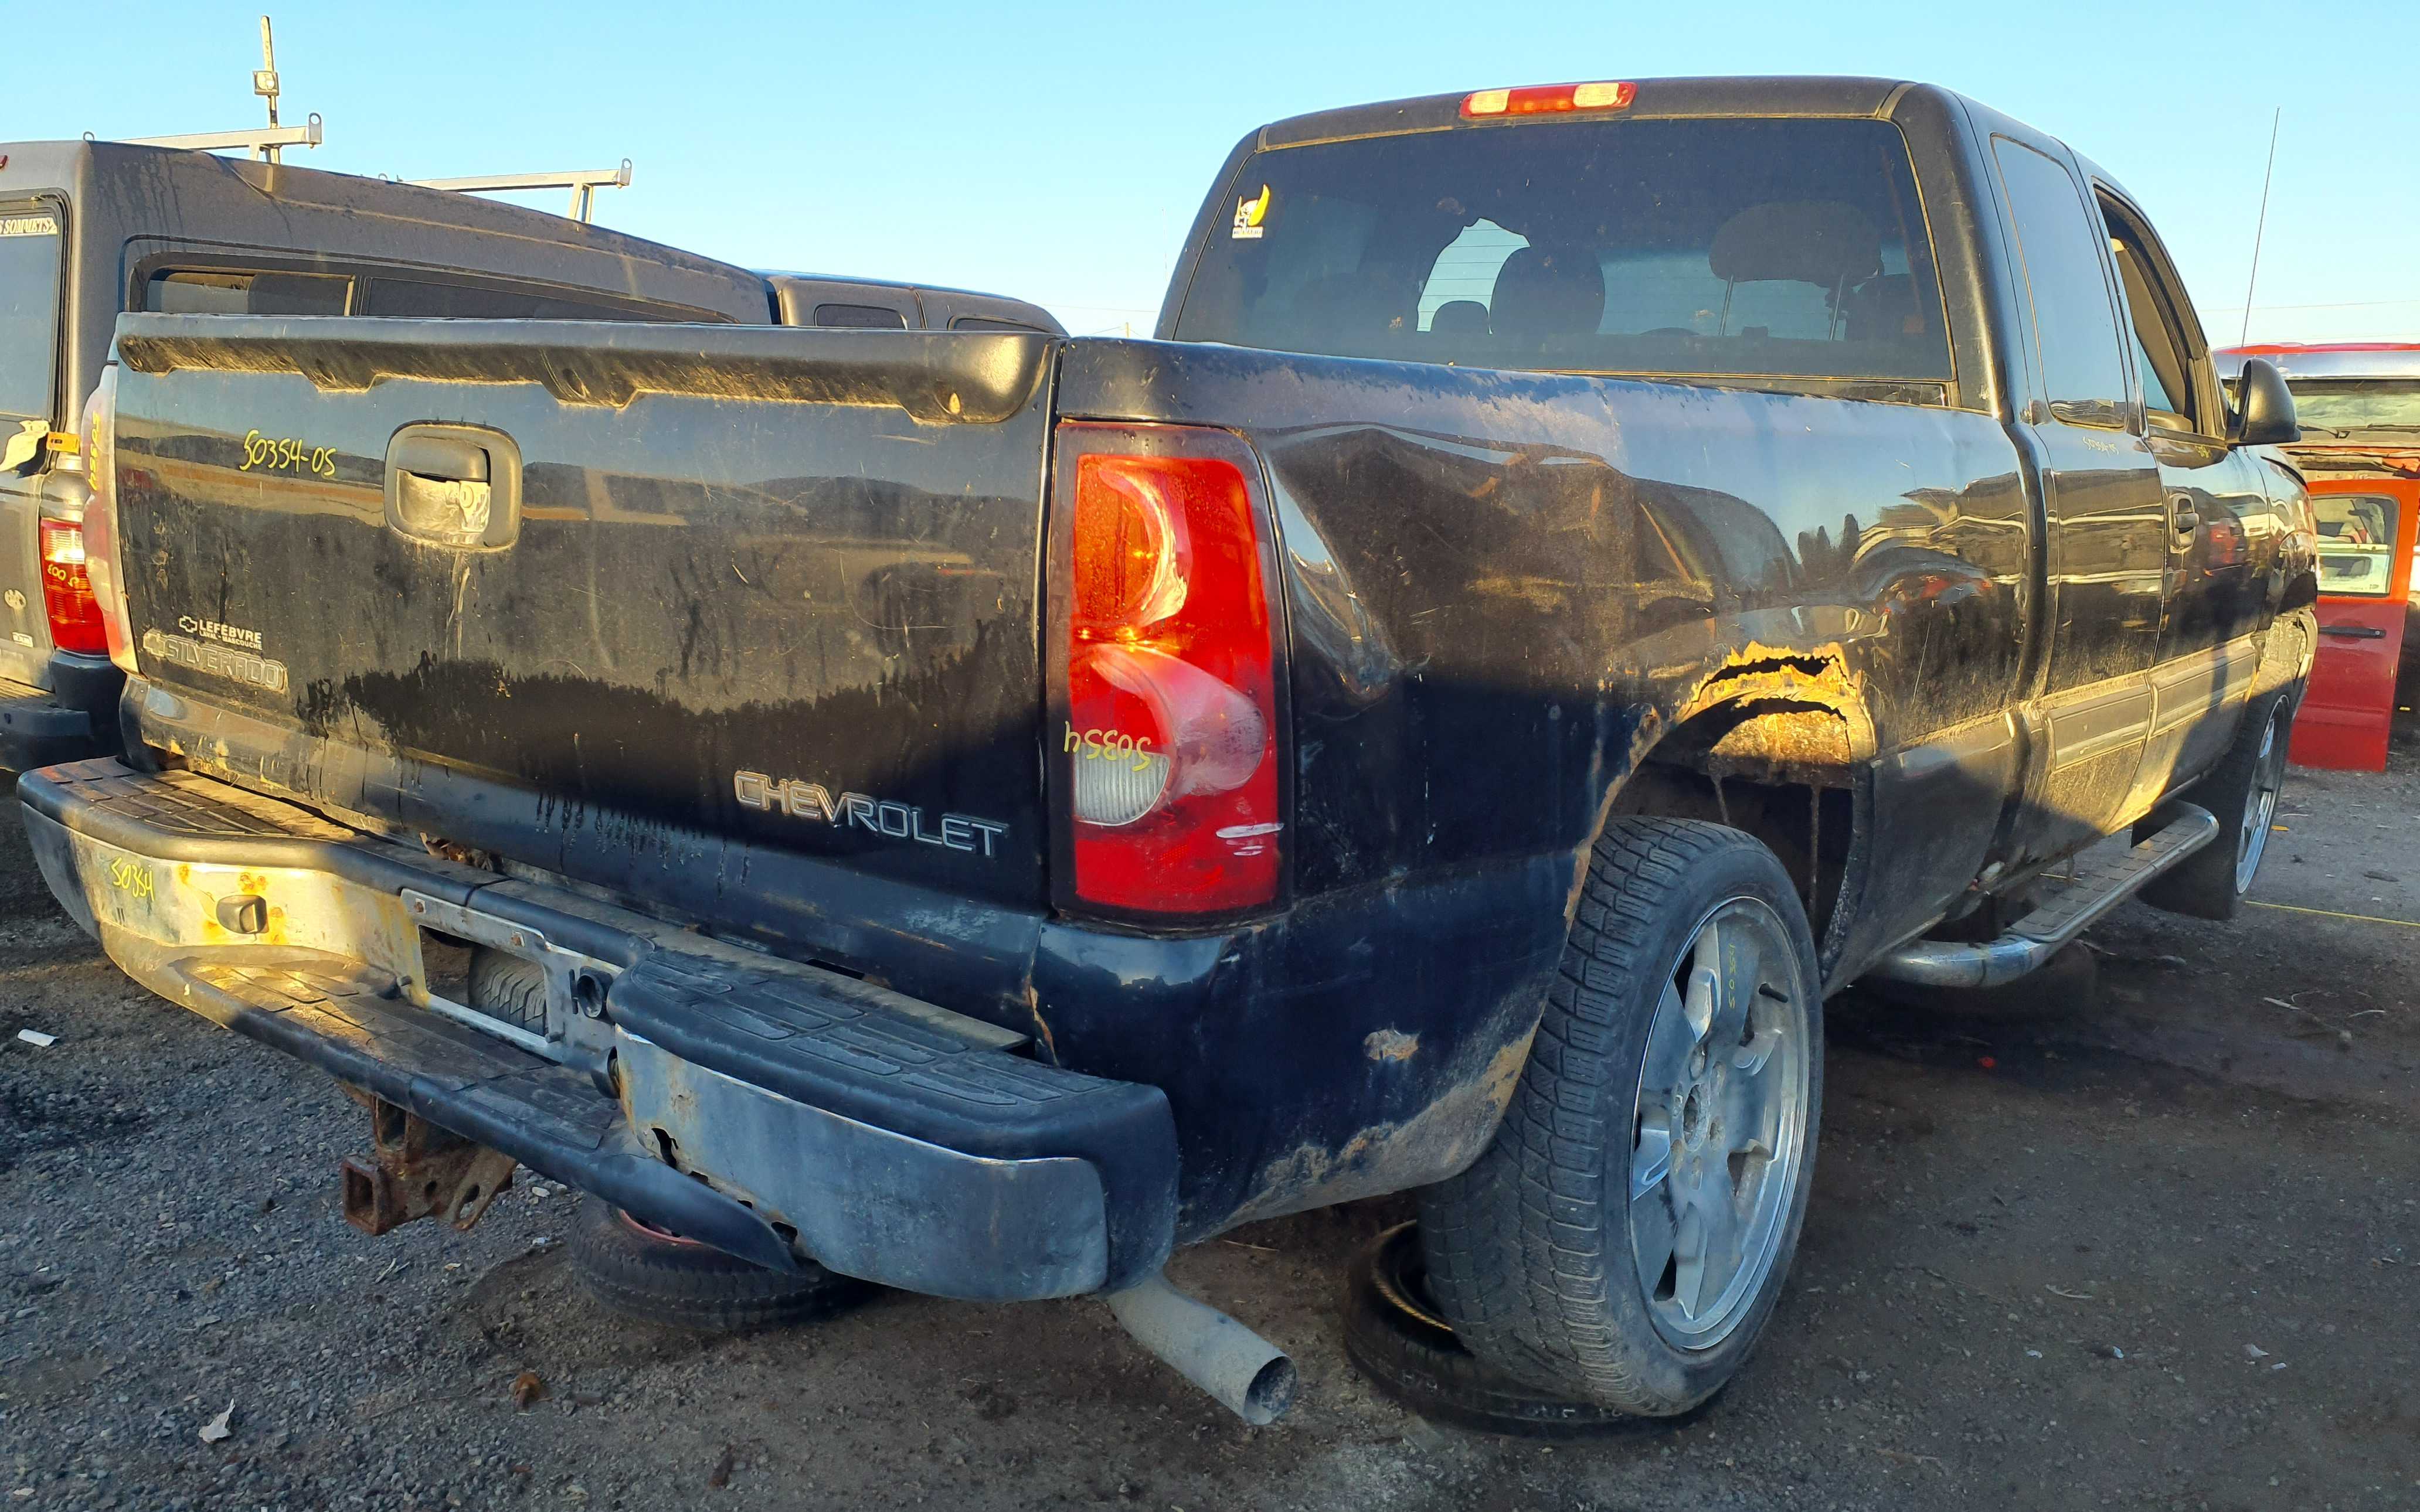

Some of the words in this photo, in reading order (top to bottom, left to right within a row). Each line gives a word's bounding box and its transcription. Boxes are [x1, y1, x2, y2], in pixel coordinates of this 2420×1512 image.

[239, 429, 336, 476] 50354-05
[199, 618, 262, 643] LEFEBVRE
[199, 630, 218, 640] LAVAL
[222, 635, 263, 651] MASCOUCHE
[164, 637, 283, 690] SILVERADO
[734, 770, 1010, 857] CHEVROLET
[111, 857, 154, 901] 50354
